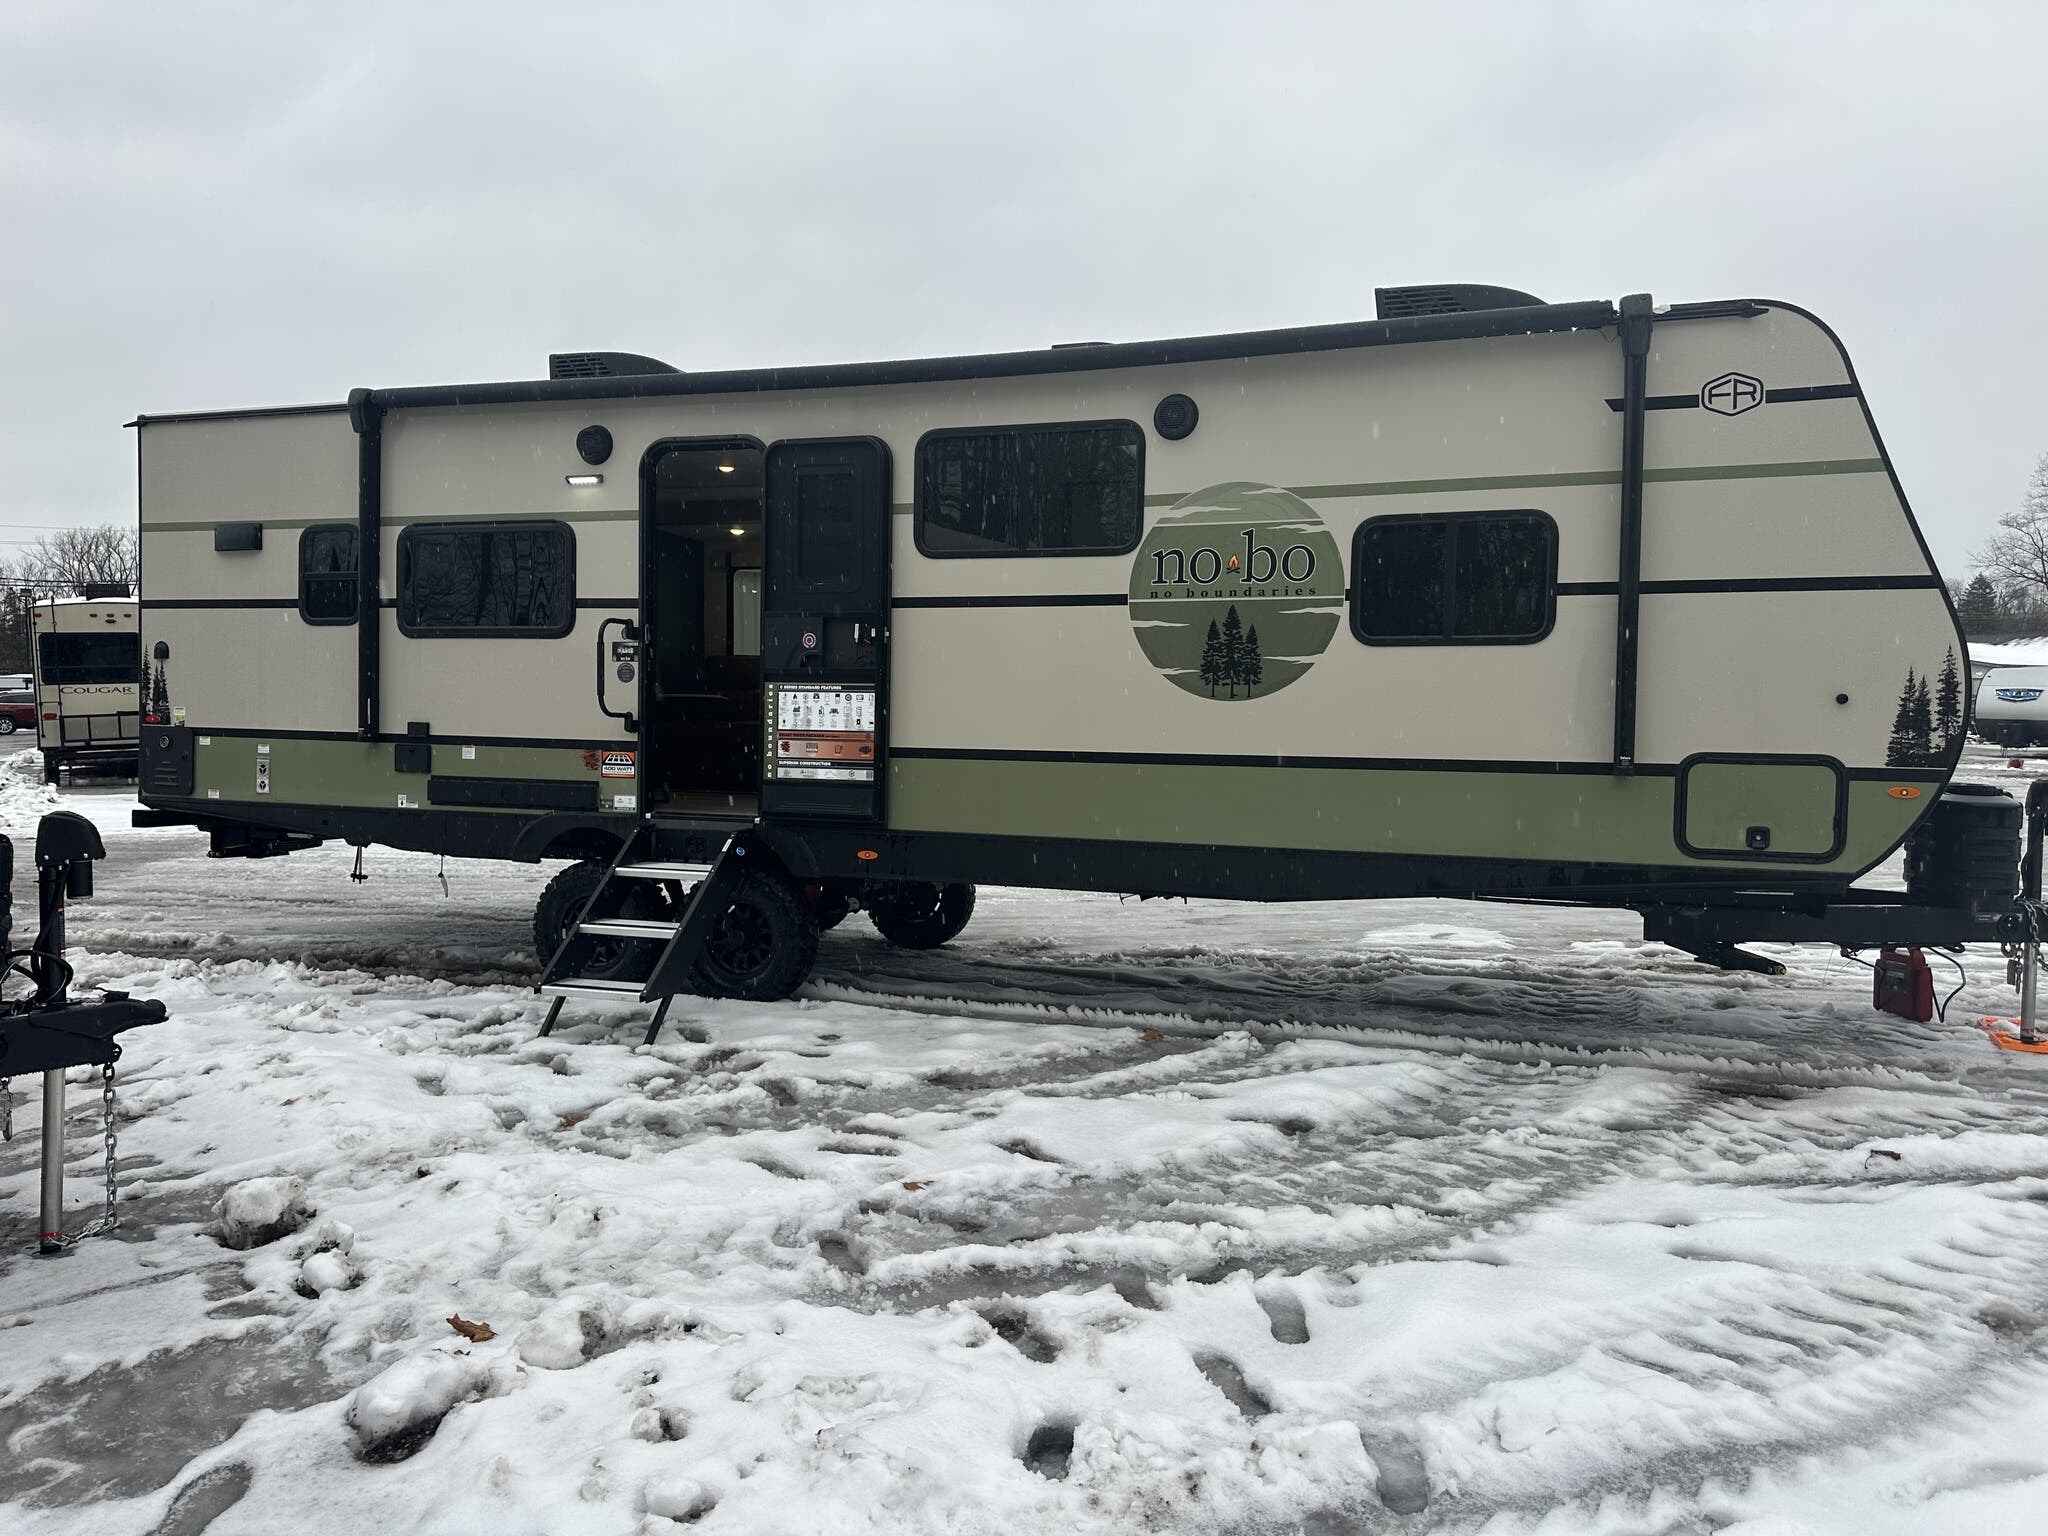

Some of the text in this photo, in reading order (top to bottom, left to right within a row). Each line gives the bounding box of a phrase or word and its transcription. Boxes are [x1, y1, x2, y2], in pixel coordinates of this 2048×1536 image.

[1150, 586, 1316, 599] no boundaries
[60, 686, 133, 694] COUGAR
